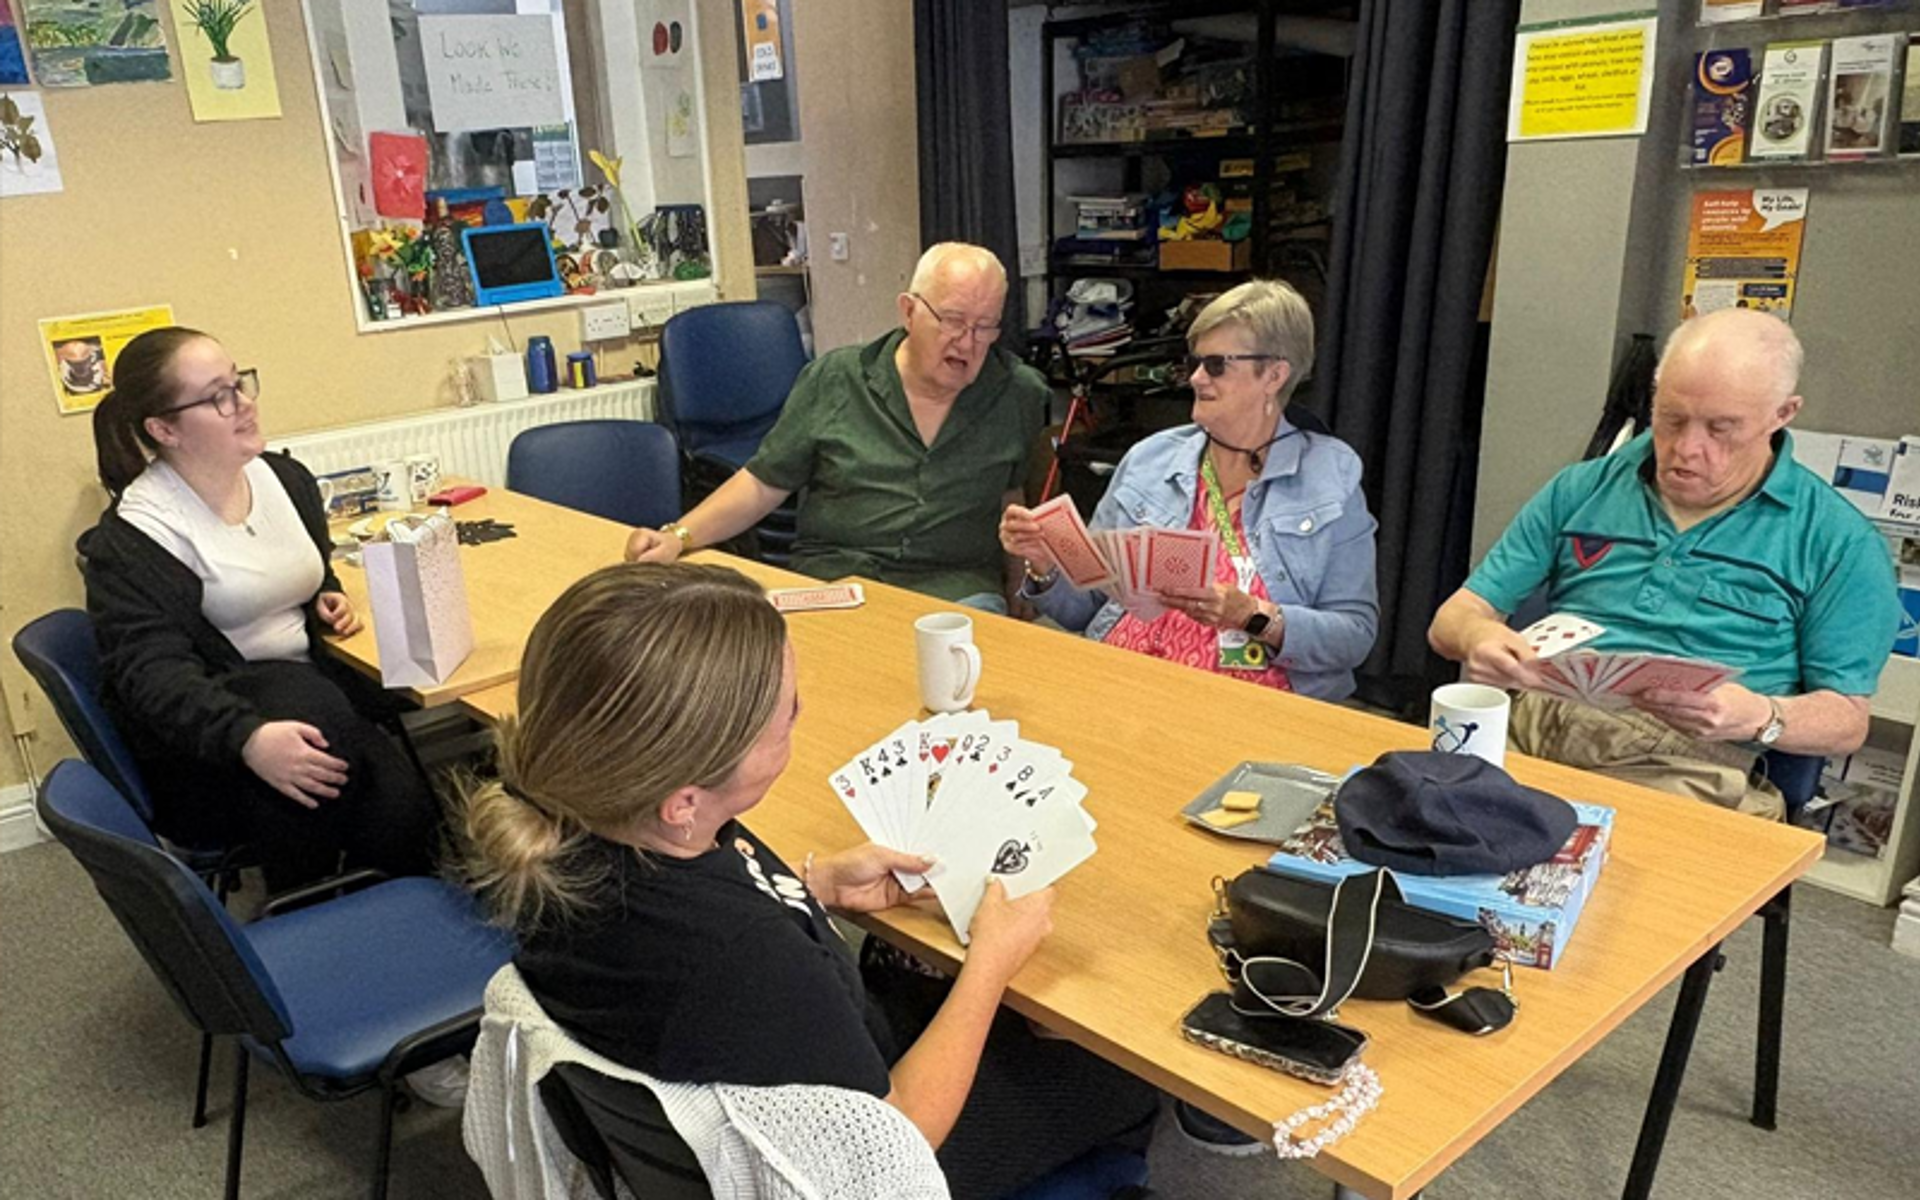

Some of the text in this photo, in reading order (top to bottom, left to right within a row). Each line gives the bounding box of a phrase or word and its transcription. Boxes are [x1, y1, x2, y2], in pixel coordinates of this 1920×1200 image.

[1892, 494, 1920, 508] Ris
[974, 734, 990, 751] 2
[996, 746, 1012, 761] 3
[859, 757, 875, 776] K
[1017, 765, 1034, 781] 8
